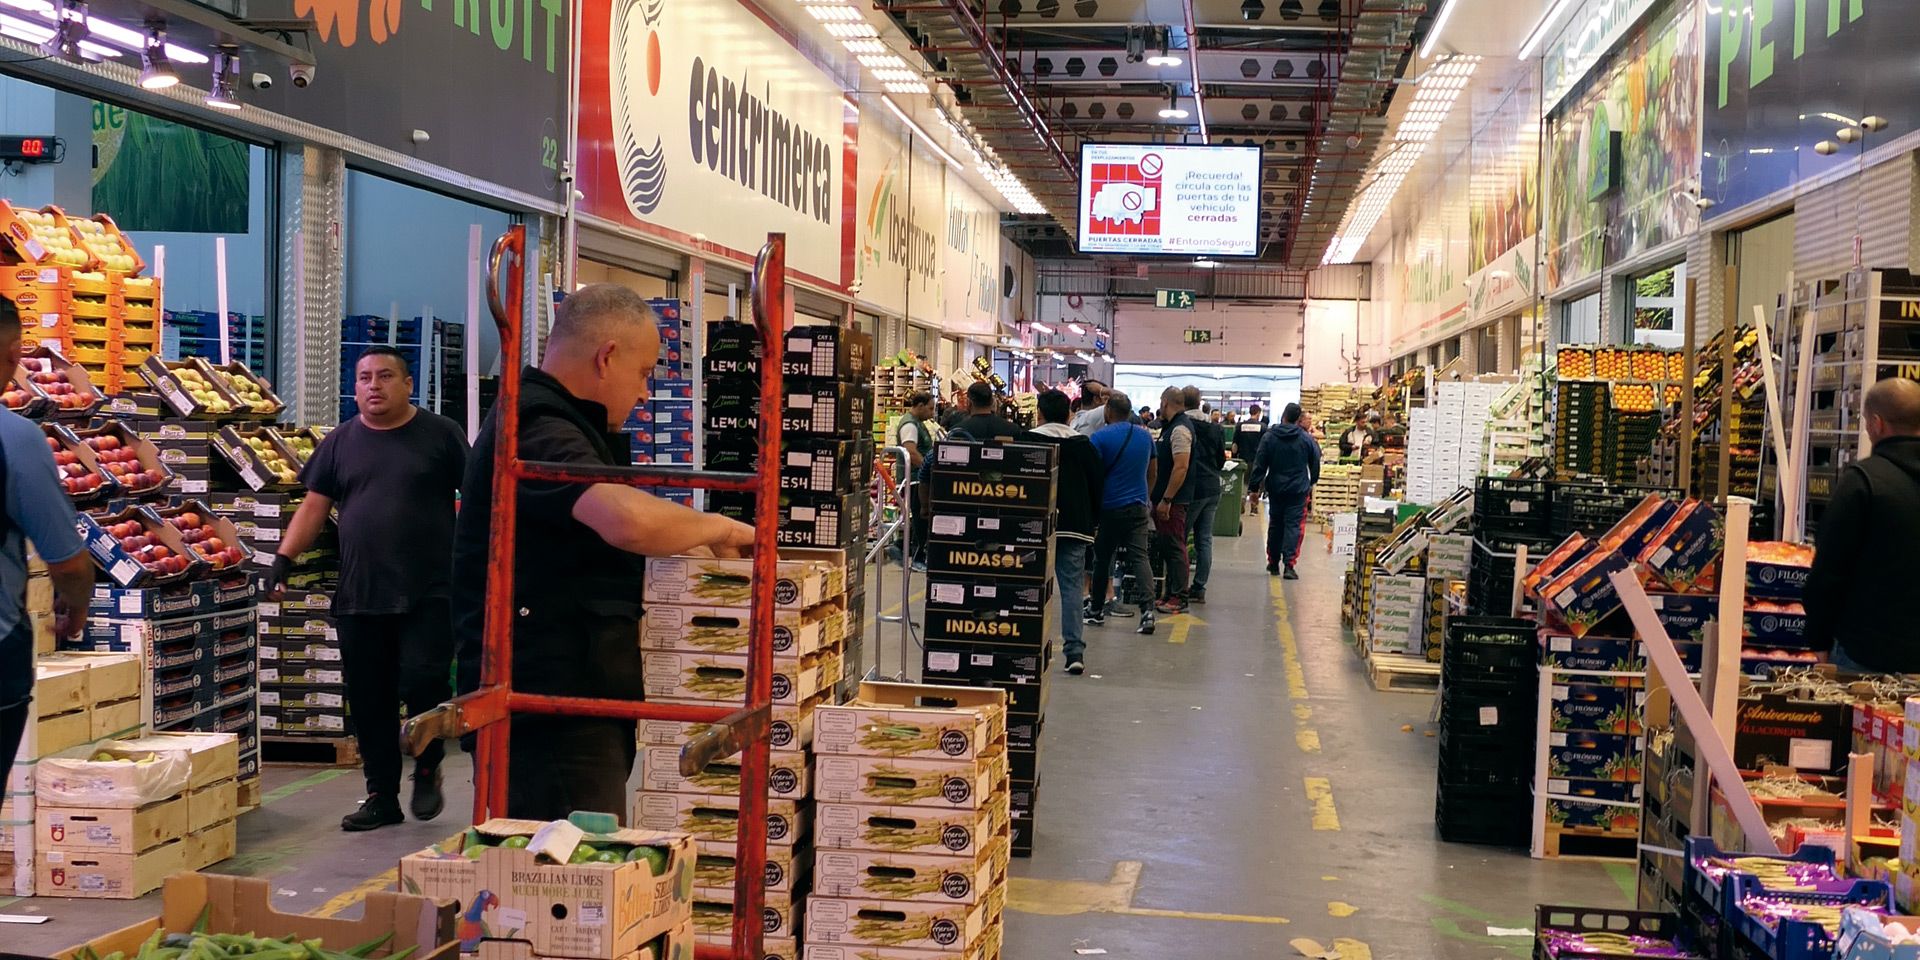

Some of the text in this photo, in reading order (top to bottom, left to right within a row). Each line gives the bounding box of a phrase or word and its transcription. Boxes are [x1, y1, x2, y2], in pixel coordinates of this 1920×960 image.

[689, 56, 831, 226] centrimerca
[542, 136, 557, 170] 22
[1185, 170, 1243, 181] ¡Recuerda!
[1237, 183, 1251, 192] las
[1177, 193, 1249, 202] puertas de tu
[1187, 213, 1238, 222] cerradas
[1169, 237, 1251, 248] #EntornoSeguro
[711, 360, 756, 373] LEMON
[711, 417, 757, 429] LEMON
[952, 481, 1027, 499] INDASOL
[949, 551, 1023, 568] INDASOL
[946, 619, 1020, 636] INDASOL
[1744, 704, 1823, 723] Aniversario
[512, 872, 604, 886] BRAZILIAN LIMES
[512, 884, 602, 900] MUCH MORE JUICE
